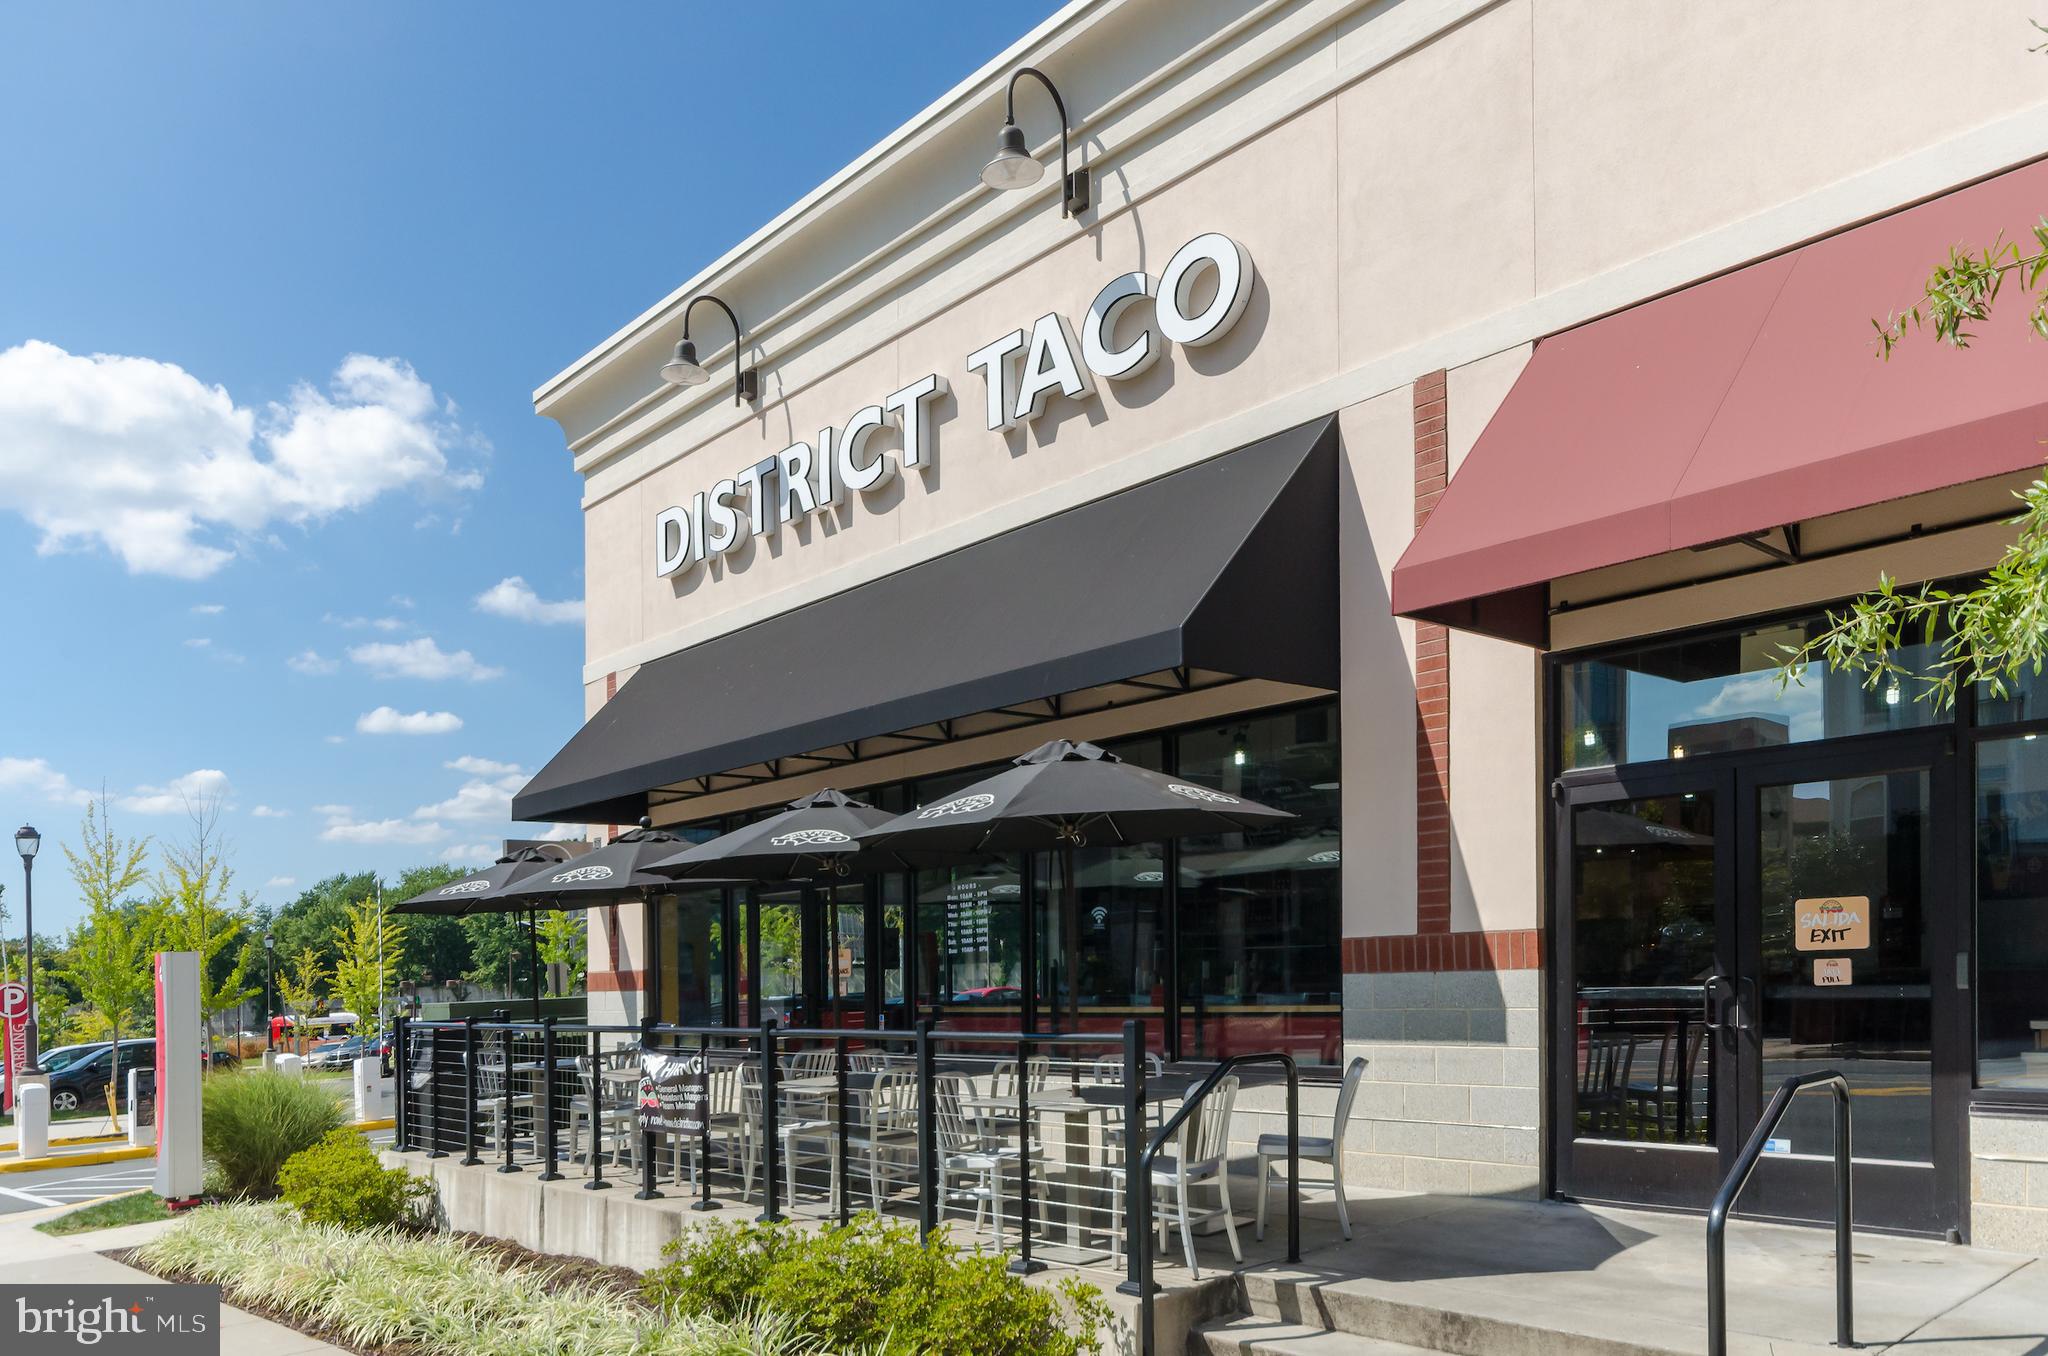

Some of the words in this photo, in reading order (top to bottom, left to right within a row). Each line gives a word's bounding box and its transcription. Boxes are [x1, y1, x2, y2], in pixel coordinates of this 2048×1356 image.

[656, 373, 947, 579] DISTRICT
[967, 232, 1255, 432] TACO
[1800, 911, 1862, 929] SALIDA
[1810, 928, 1852, 943] EXIT
[4, 988, 25, 1014] P
